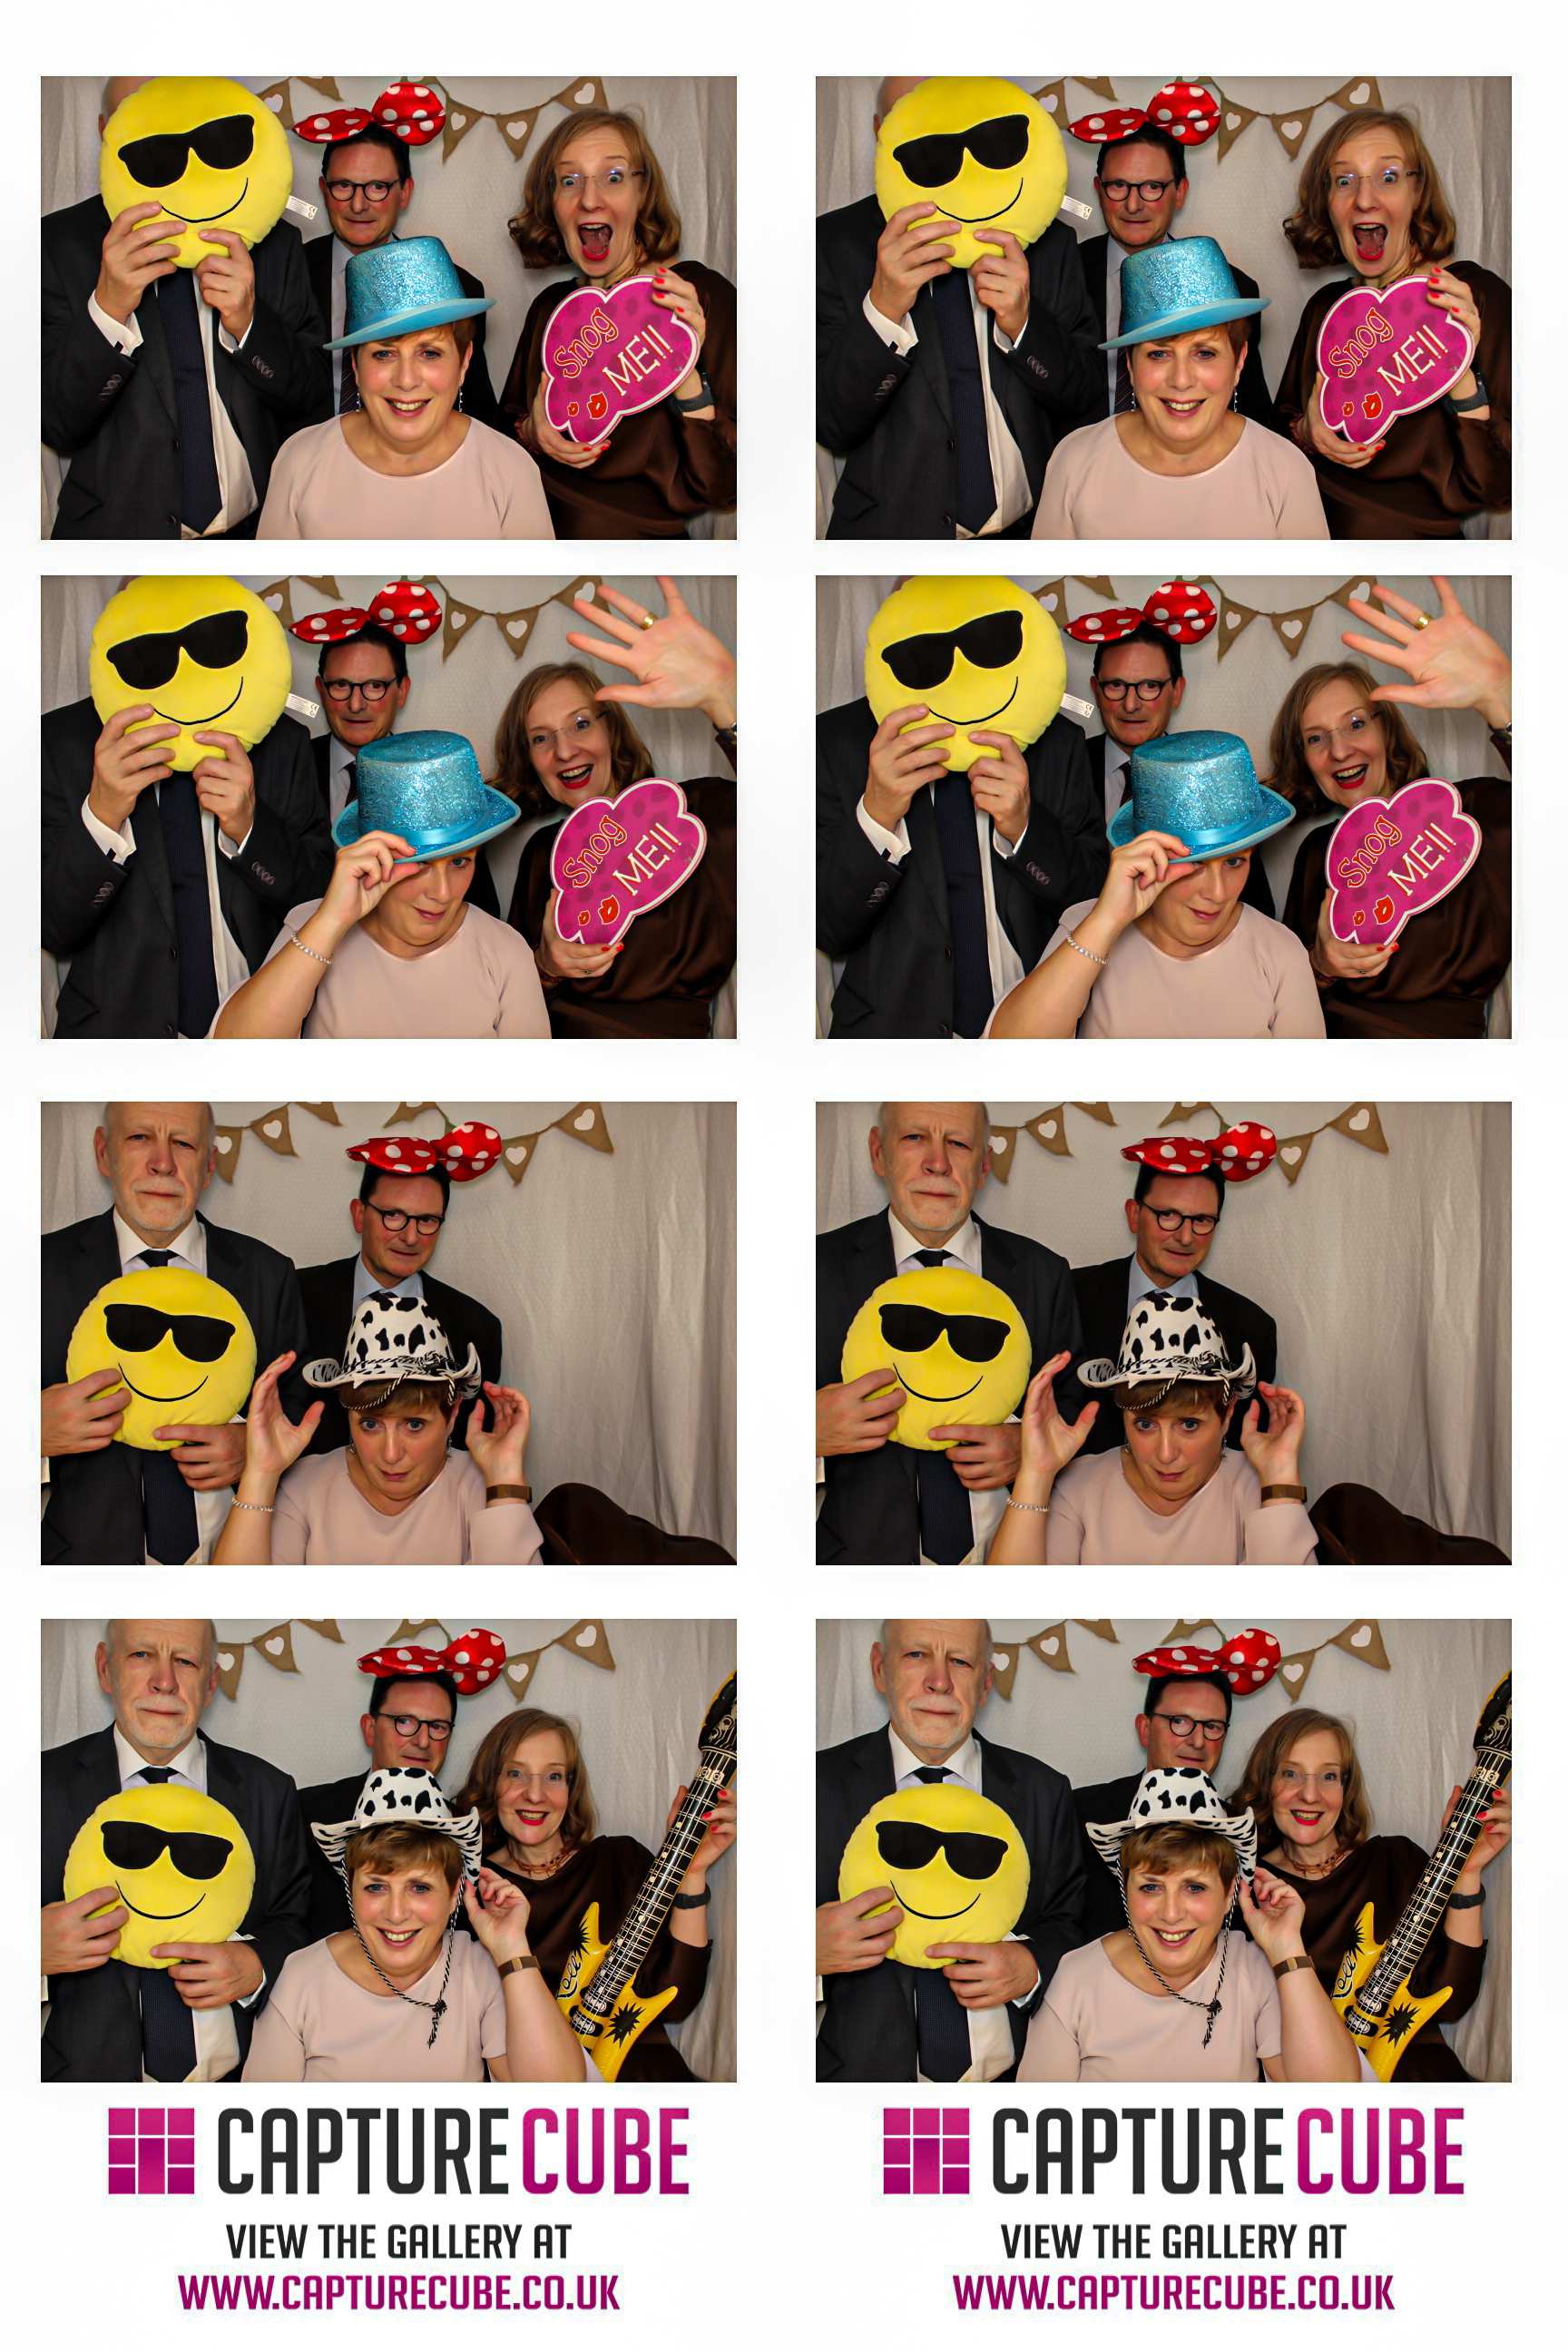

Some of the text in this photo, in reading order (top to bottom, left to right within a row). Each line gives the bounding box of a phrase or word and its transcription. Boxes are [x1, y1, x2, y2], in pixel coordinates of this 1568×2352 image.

[554, 307, 620, 378] Snog
[602, 324, 674, 397] ME!!
[1328, 307, 1395, 378] Snog
[1377, 324, 1449, 397] ME!!
[563, 814, 628, 888] Snog
[612, 822, 682, 897] ME!!
[1338, 814, 1403, 888] Snog
[1387, 822, 1457, 897] ME!!
